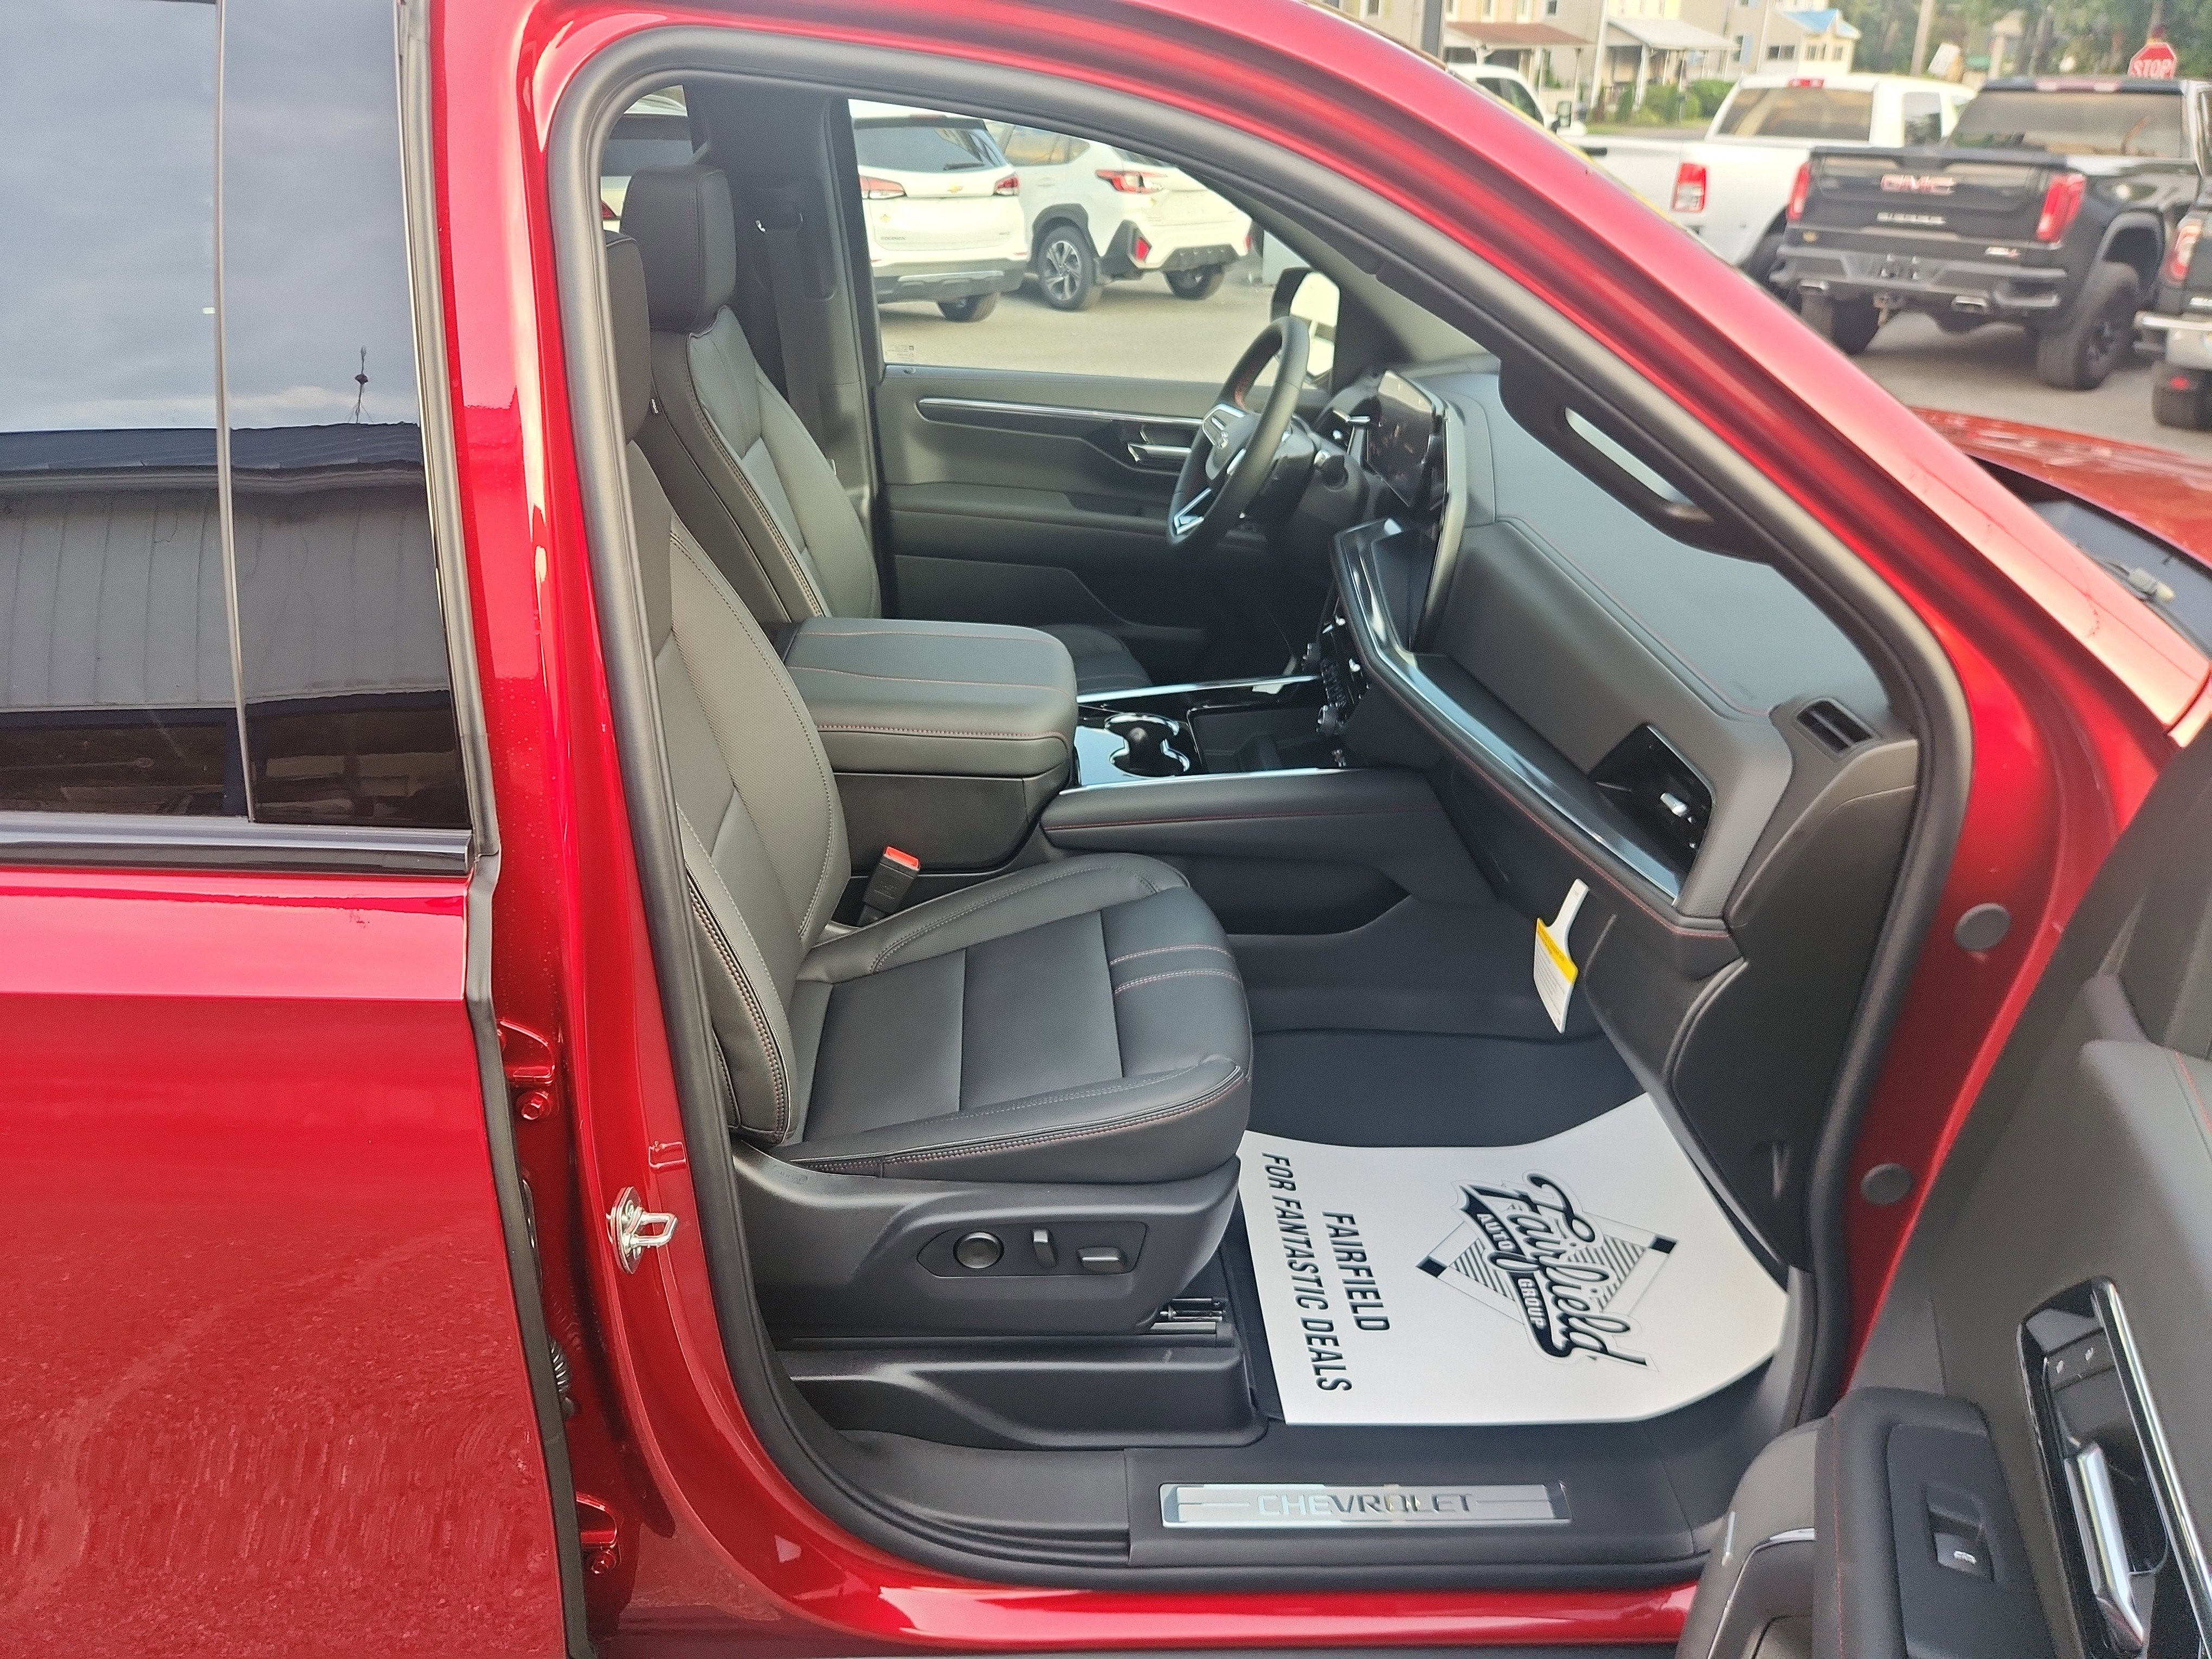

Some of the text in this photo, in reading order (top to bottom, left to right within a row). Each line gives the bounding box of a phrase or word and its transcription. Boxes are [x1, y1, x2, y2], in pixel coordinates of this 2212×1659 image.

[2131, 59, 2173, 79] STOP
[1880, 173, 1956, 195] GMC
[1477, 1213, 1515, 1252] AUTO
[1262, 1152, 1352, 1391] FOR FANTASTIC DEALS
[1322, 1211, 1390, 1332] FAIRFIELD
[1467, 1172, 1648, 1367] Fairfield
[1517, 1278, 1546, 1329] GROUP
[1257, 1494, 1472, 1515] CHEVROLET
